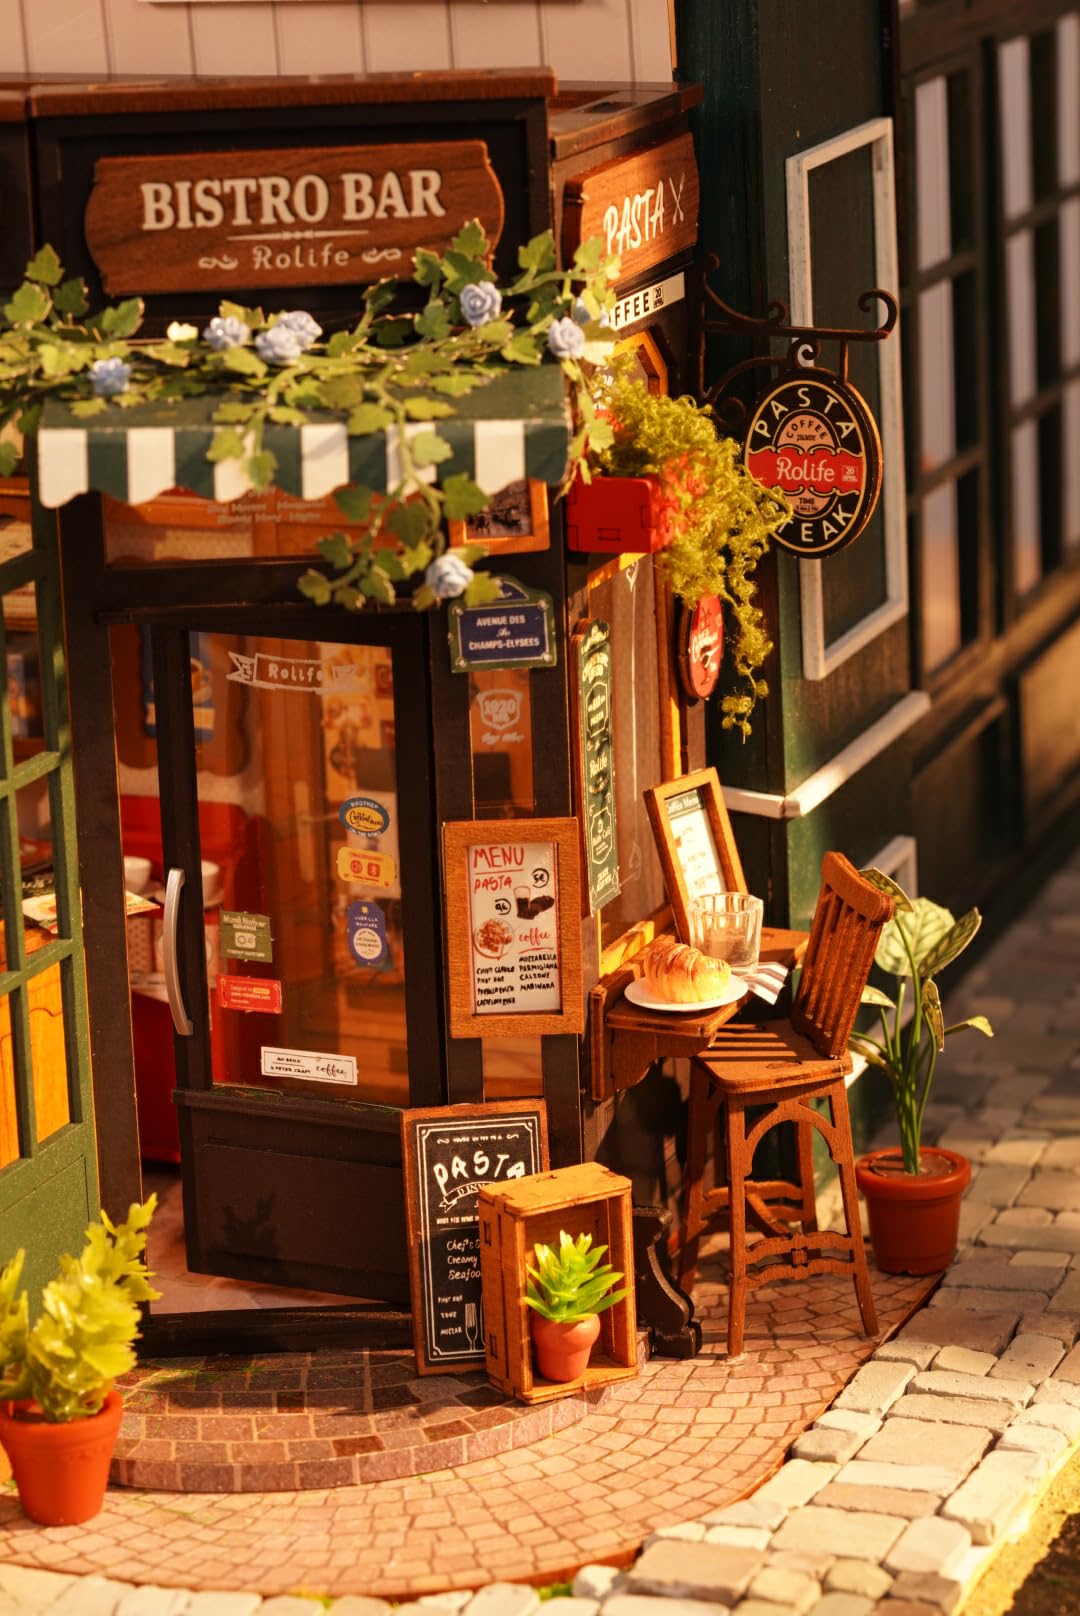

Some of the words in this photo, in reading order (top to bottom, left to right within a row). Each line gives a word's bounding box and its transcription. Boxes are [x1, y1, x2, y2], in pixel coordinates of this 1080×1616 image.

[140, 174, 330, 231] BISTRO
[341, 169, 446, 221] BAR
[603, 180, 665, 257] PASTA
[252, 243, 350, 270] Rolife
[609, 291, 651, 327] FFEE
[754, 387, 856, 439] PASTA
[786, 420, 828, 441] COFFEE
[776, 456, 836, 483] Rolife
[476, 616, 508, 627] AVENUE
[509, 614, 527, 625] DES
[468, 636, 540, 651] CHAMPS-ELYSEES
[473, 845, 525, 868] MENU
[474, 875, 513, 894] PASTA
[518, 927, 550, 946] coffee
[316, 1063, 345, 1077] coffee
[433, 1150, 526, 1196] PASTA
[448, 1268, 481, 1282] Seafoo
